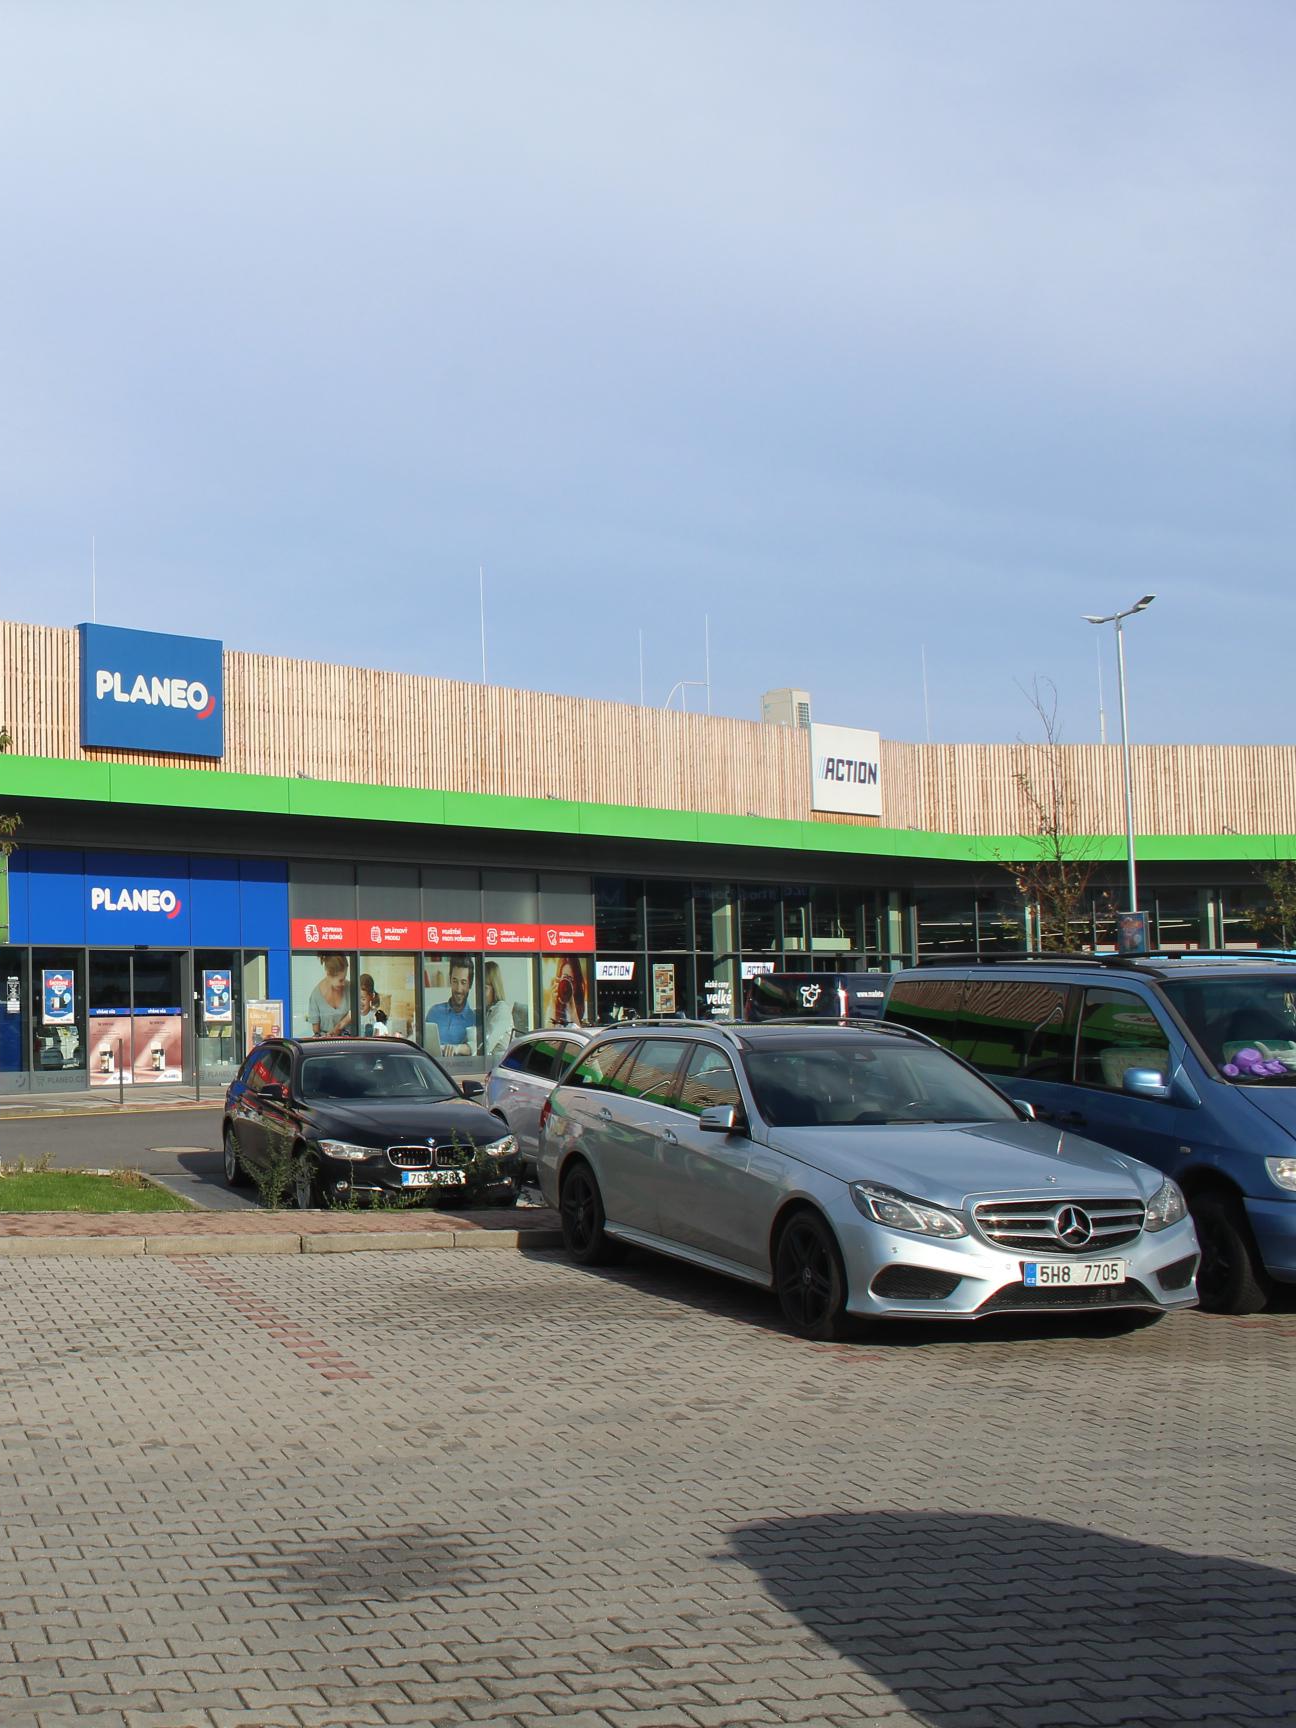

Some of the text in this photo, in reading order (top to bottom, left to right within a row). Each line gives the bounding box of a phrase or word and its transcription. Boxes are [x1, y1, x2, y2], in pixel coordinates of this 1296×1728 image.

[96, 670, 209, 711] PLANEO
[824, 757, 878, 785] ACTION
[91, 887, 176, 912] PLANEO
[602, 965, 630, 977] ACTION
[746, 965, 771, 976] ACTION
[706, 989, 732, 1005] velké
[1040, 1263, 1119, 1284] 5H8 7705
